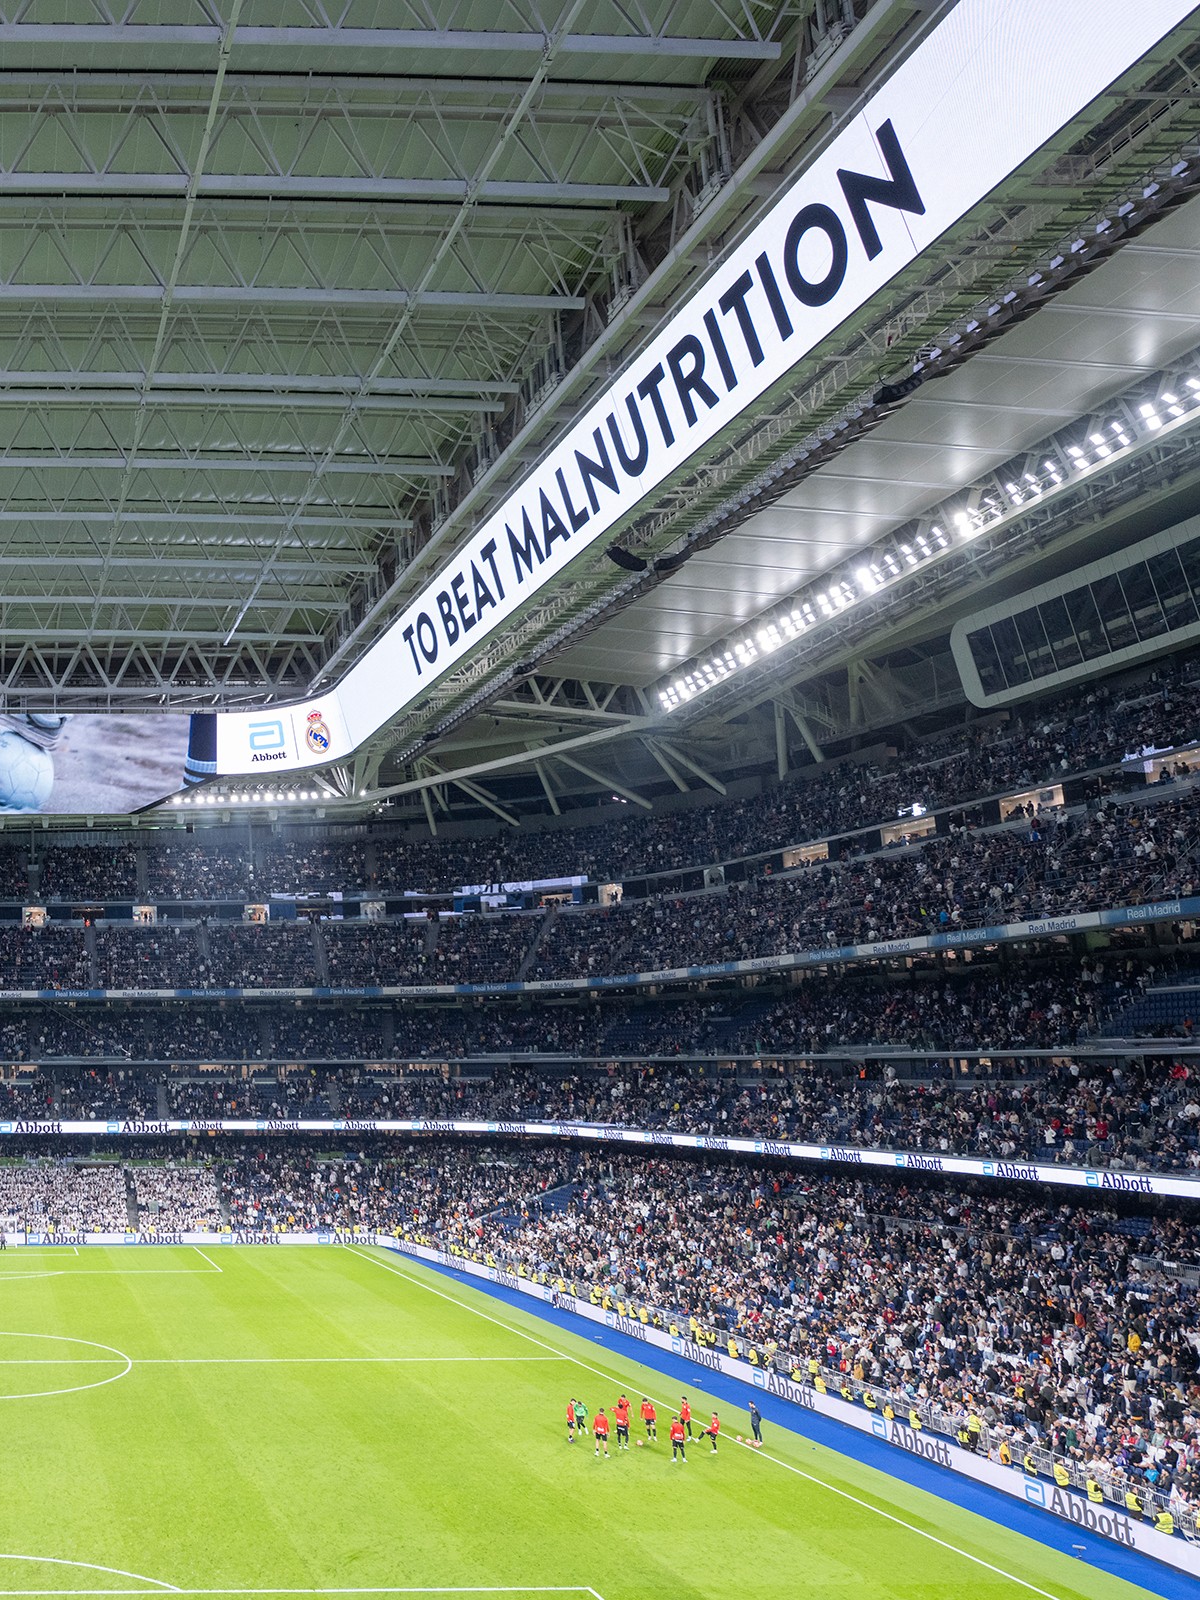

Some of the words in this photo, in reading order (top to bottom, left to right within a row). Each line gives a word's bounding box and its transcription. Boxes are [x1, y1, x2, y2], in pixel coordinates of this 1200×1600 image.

[402, 611, 438, 676] TO
[436, 537, 506, 647] BEAT
[504, 117, 926, 585] MALNUTRITION
[251, 751, 287, 762] Abbott
[1126, 905, 1145, 919] Real
[1148, 902, 1180, 916] Madrid
[1029, 923, 1045, 933] Real
[1048, 919, 1076, 930] Madrid
[947, 932, 962, 943] Real
[963, 930, 986, 941] Madrid
[873, 946, 887, 954] Real
[888, 942, 910, 952] Madrid
[810, 952, 820, 960] Real
[822, 950, 840, 958] Madrid
[752, 961, 762, 969] Real
[763, 959, 780, 967] Madrid
[15, 1121, 62, 1133] Abbott
[122, 1121, 170, 1134] Abbott
[191, 1121, 223, 1130] Abbott
[267, 1120, 299, 1130] Abbott
[345, 1121, 376, 1130] Abbott
[423, 1121, 455, 1130] Abbott
[498, 1123, 526, 1133] Abbott
[560, 1126, 578, 1136] Abbott
[604, 1129, 623, 1140] Abbott
[651, 1132, 673, 1144] Abbott
[704, 1137, 729, 1150] Abbott
[764, 1143, 792, 1156] Abbott
[830, 1148, 862, 1163] Abbott
[907, 1154, 943, 1170] Abbott
[996, 1163, 1039, 1180] Abbott
[1102, 1173, 1153, 1193] Abbott
[42, 1233, 87, 1244] Abbott
[139, 1232, 184, 1244] Abbott
[235, 1232, 280, 1244] Abbott
[333, 1234, 378, 1245] Abbott
[496, 1270, 519, 1290] Abbott
[615, 1314, 647, 1341] Abbott
[684, 1341, 722, 1371] Abbott
[768, 1373, 814, 1409] Abbott
[890, 1422, 952, 1467] Abbott
[1050, 1487, 1135, 1546] Abbott
